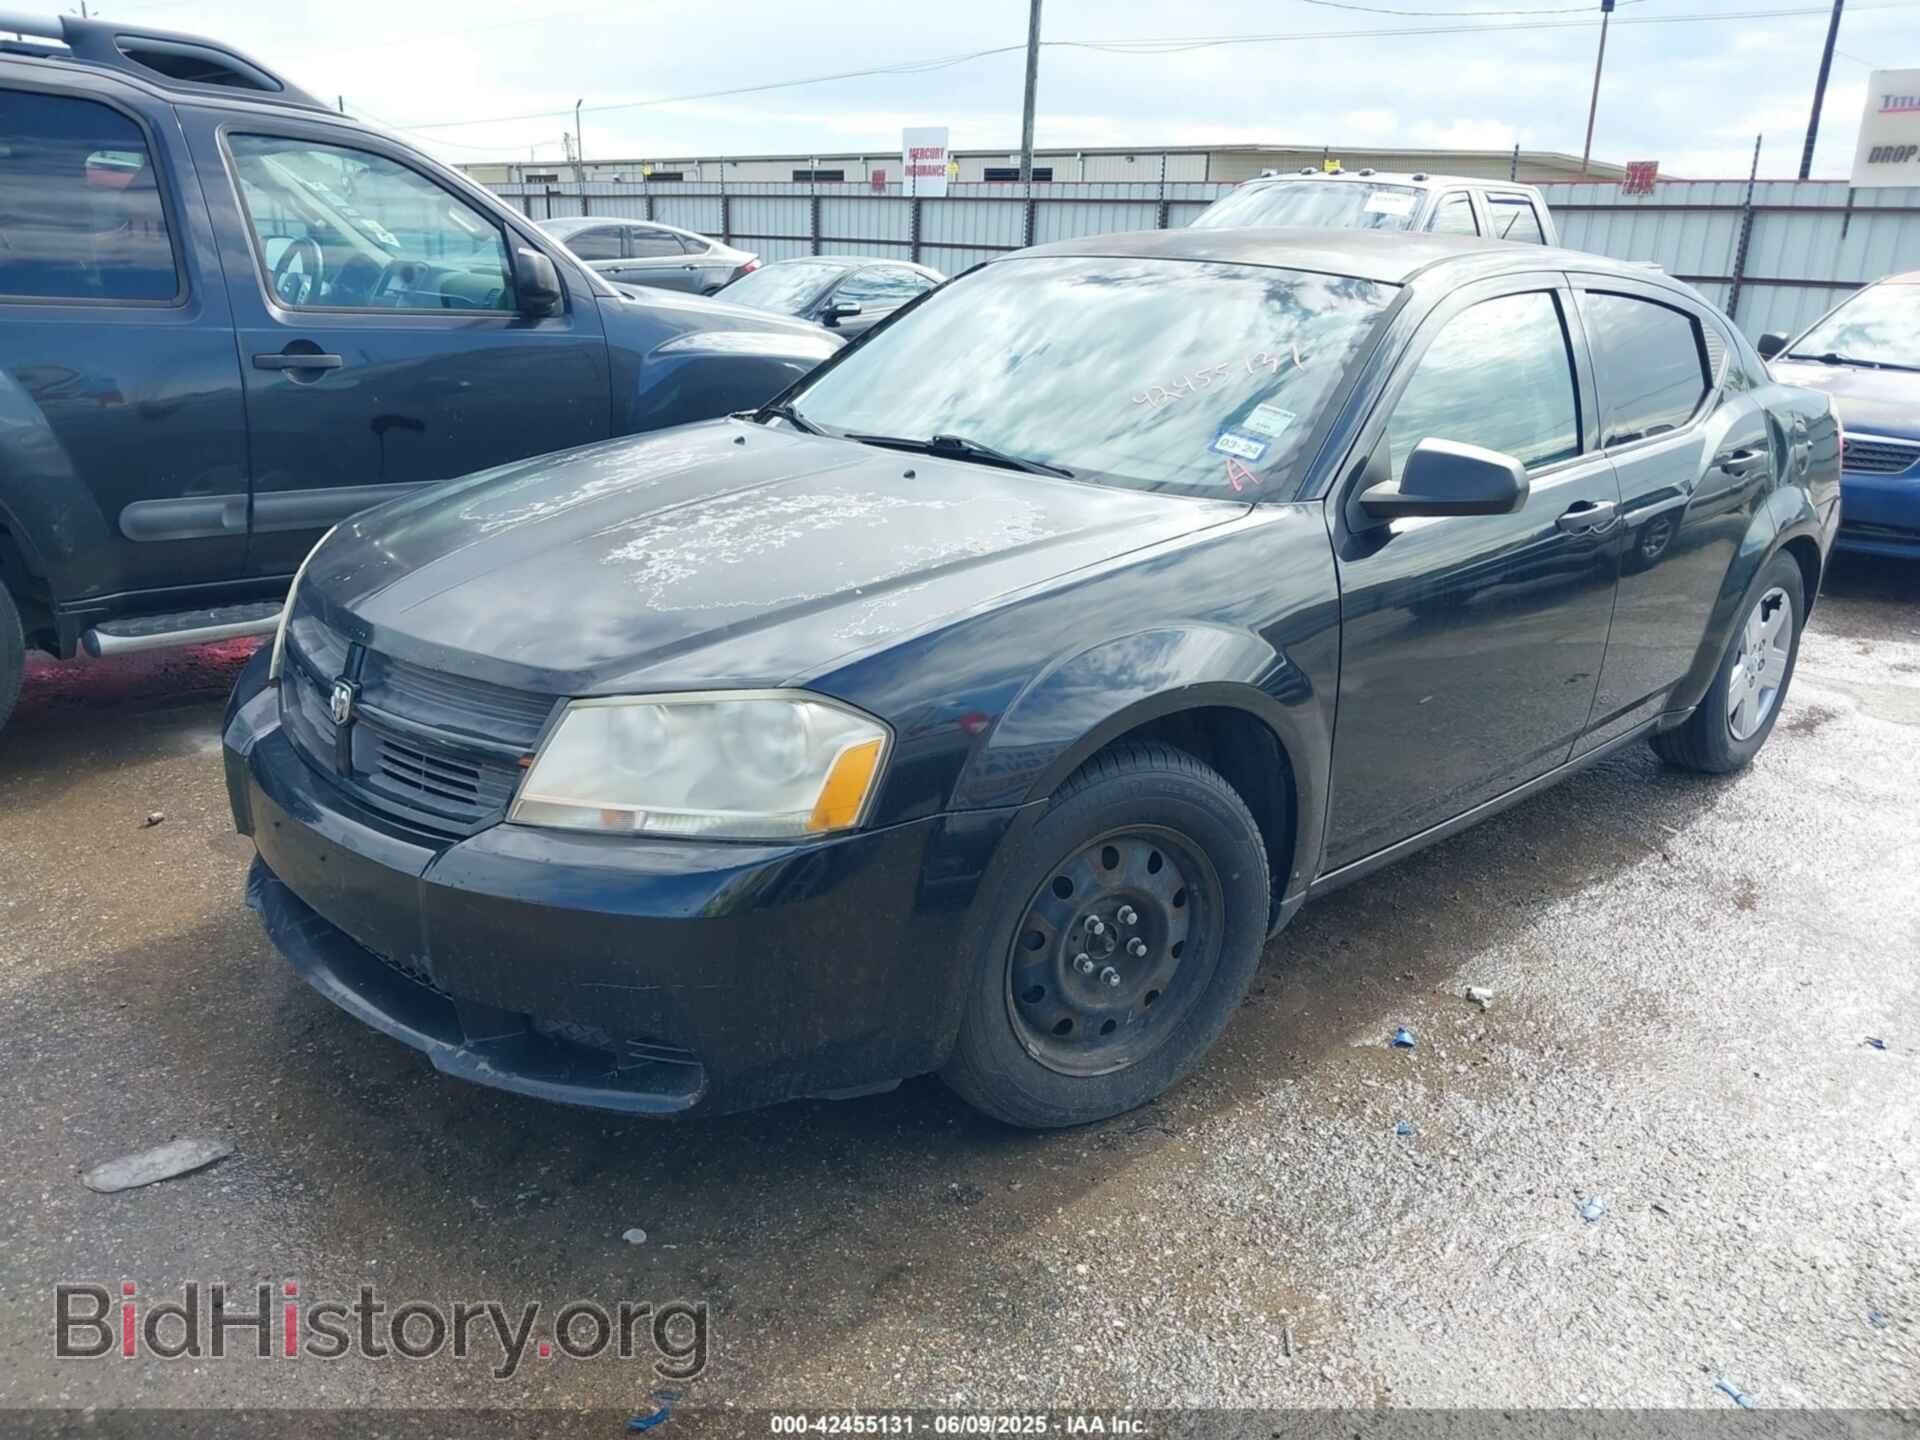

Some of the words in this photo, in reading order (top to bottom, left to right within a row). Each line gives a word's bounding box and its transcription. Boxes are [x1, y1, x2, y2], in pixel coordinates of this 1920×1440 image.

[1881, 95, 1920, 109] TITL
[909, 147, 945, 160] MERCURY
[1868, 145, 1917, 163] DROP
[905, 164, 945, 177] INURANCE
[1225, 458, 1263, 492] A
